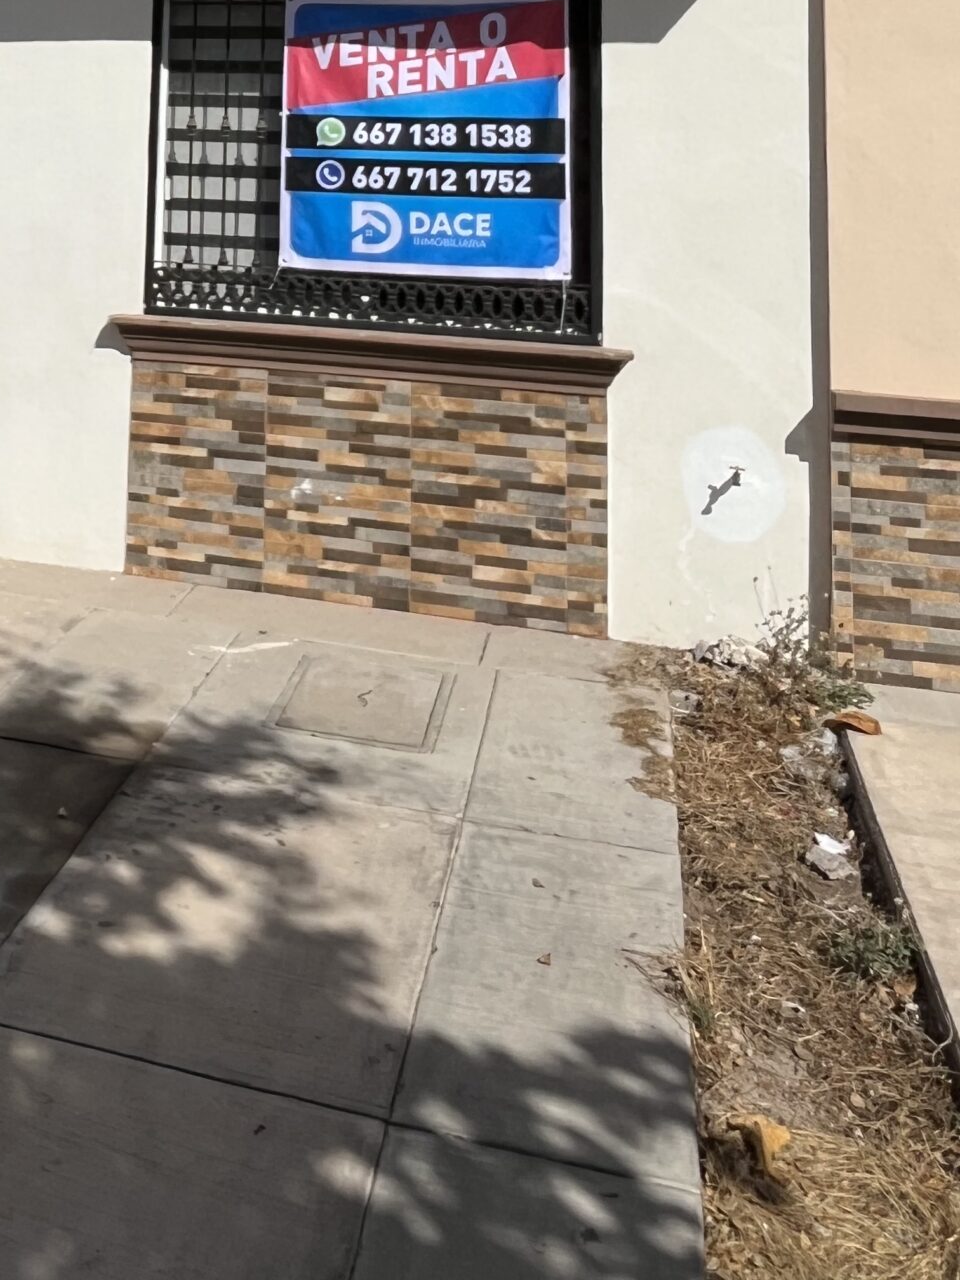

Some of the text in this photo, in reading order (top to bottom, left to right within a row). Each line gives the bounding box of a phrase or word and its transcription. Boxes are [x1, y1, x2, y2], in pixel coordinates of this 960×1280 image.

[311, 12, 507, 70] VENTA O
[367, 46, 517, 99] RENTA
[352, 122, 532, 148] 667 138 1538
[351, 166, 532, 193] 667 712 1752
[409, 211, 492, 237] DACE
